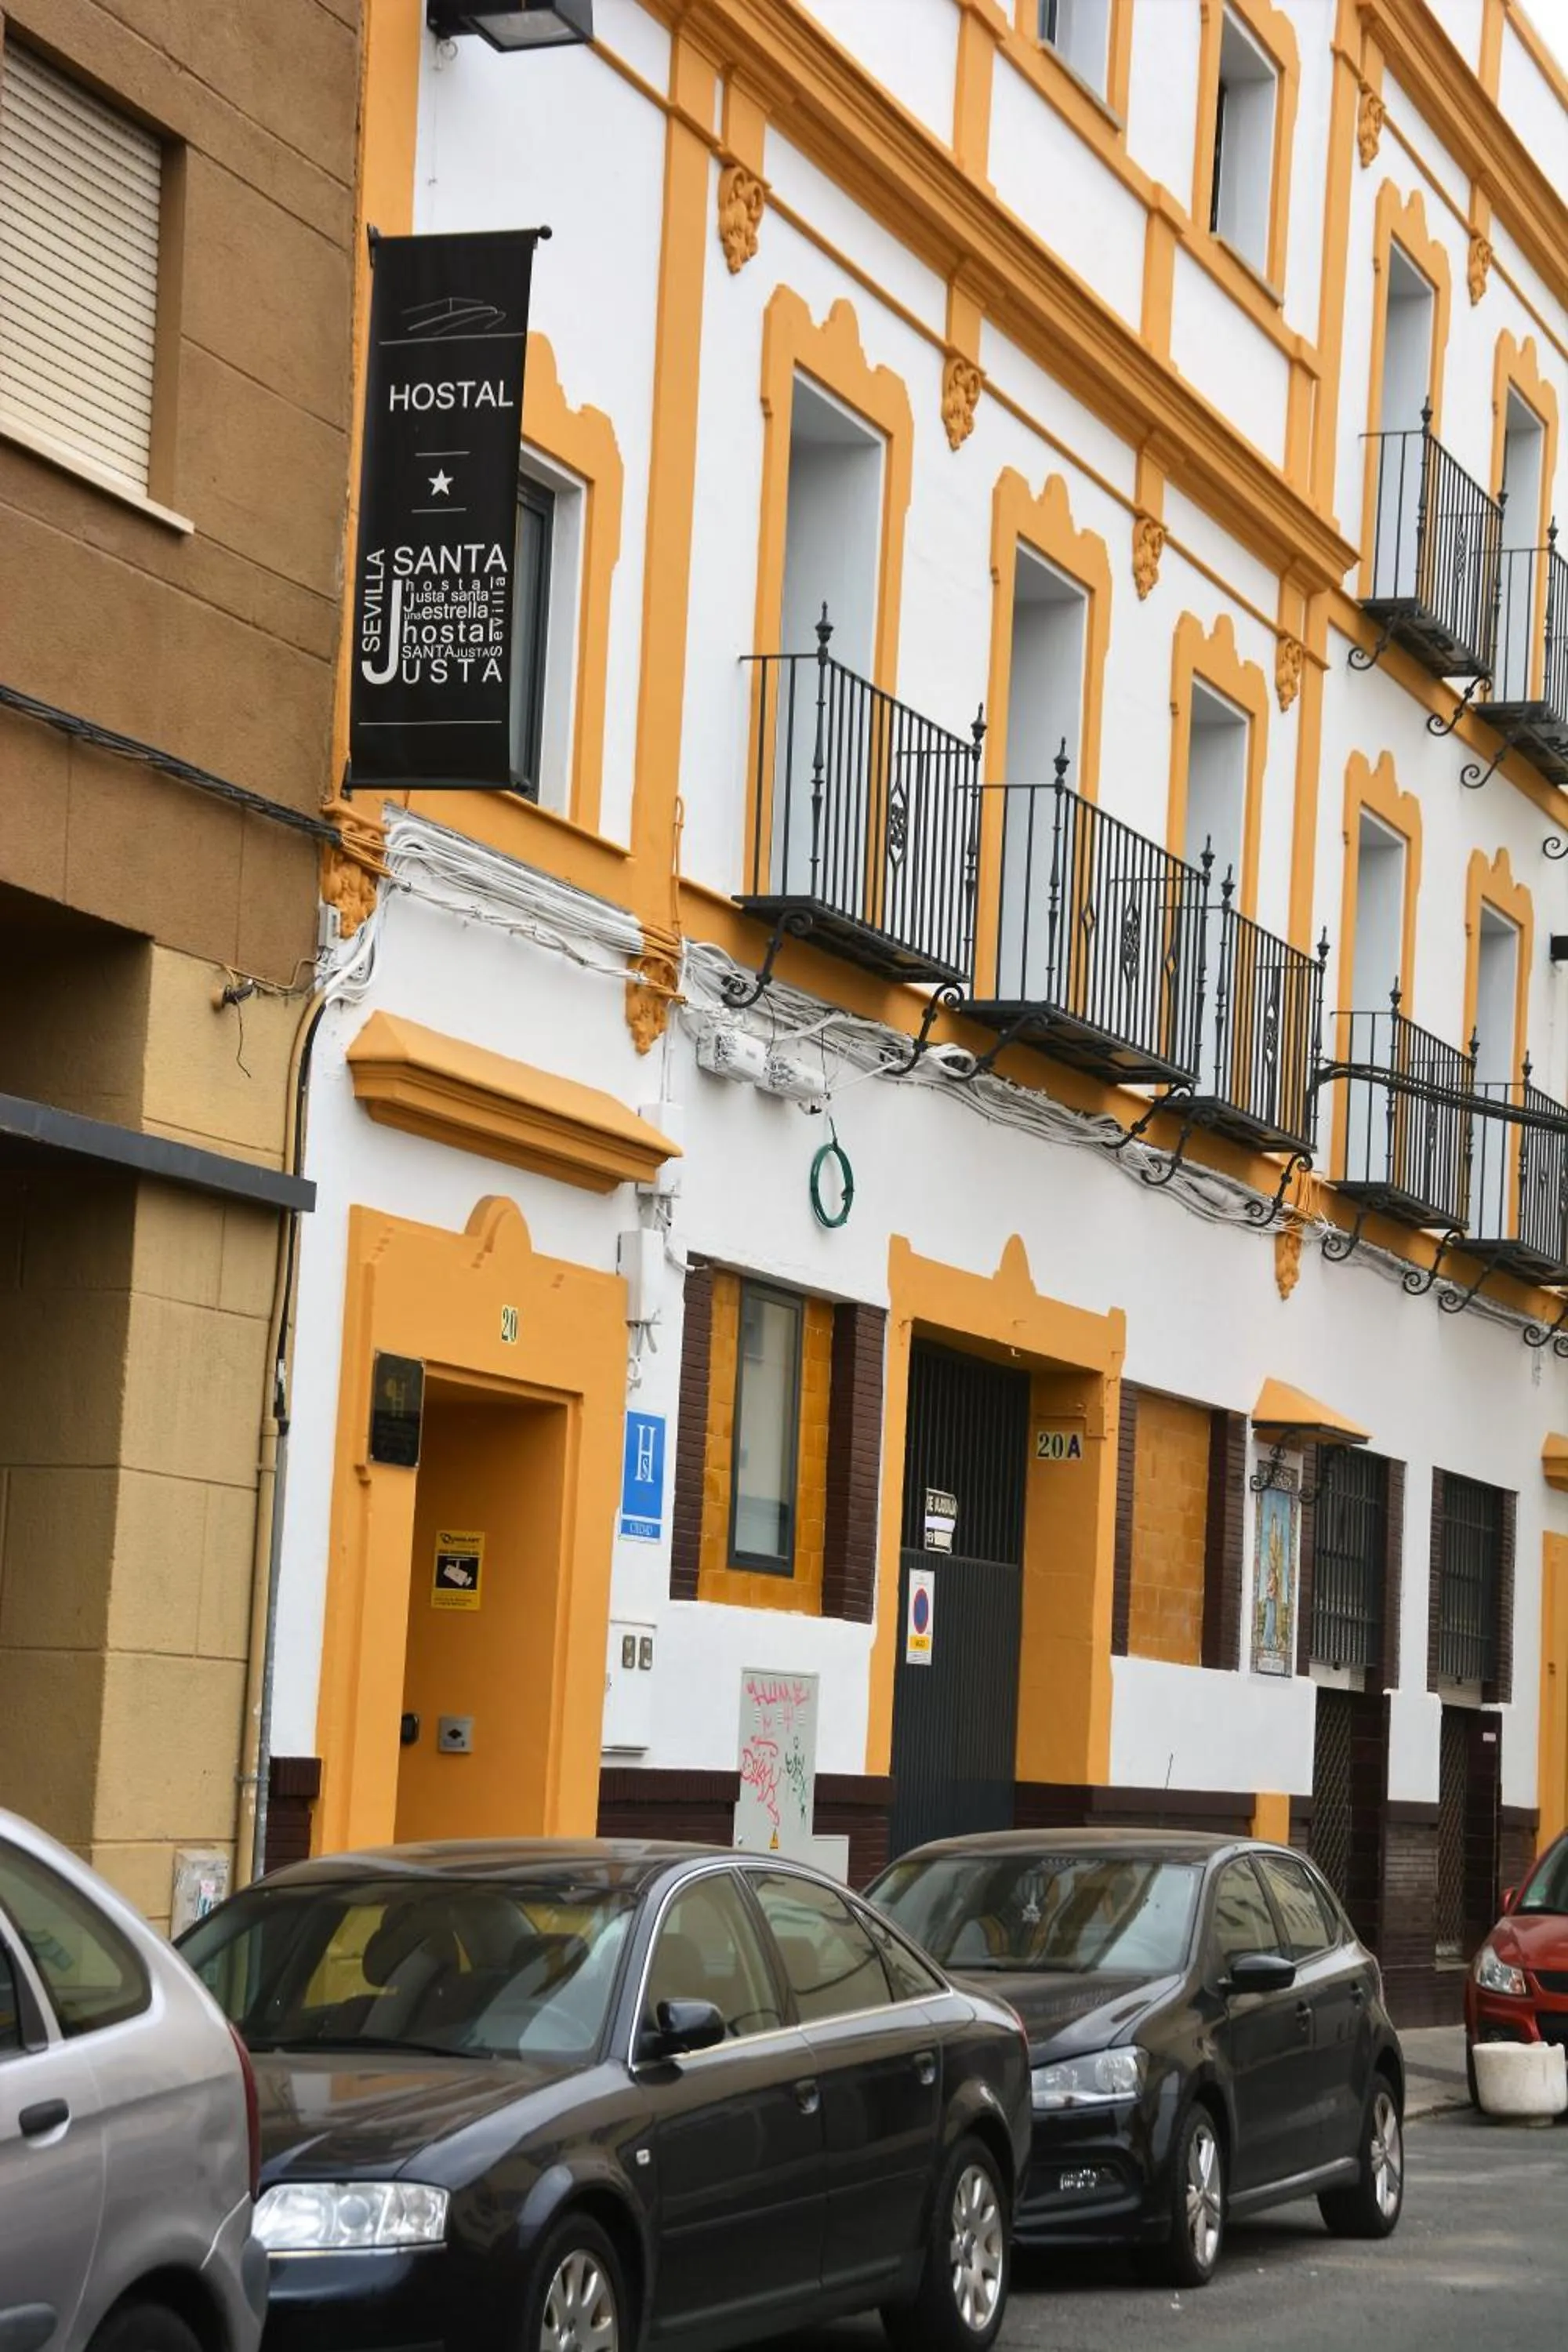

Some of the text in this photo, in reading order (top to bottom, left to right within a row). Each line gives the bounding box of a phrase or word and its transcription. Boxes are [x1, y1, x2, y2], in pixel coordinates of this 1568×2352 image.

[390, 380, 514, 412] HOSTAL
[393, 543, 507, 576] SANTA
[405, 575, 493, 592] hostal
[451, 590, 488, 601] santa
[361, 548, 385, 652] SEVILLA
[422, 601, 488, 620] estrella
[402, 617, 493, 644] hostal
[501, 1306, 517, 1342] 20
[1037, 1433, 1081, 1458] 20A
